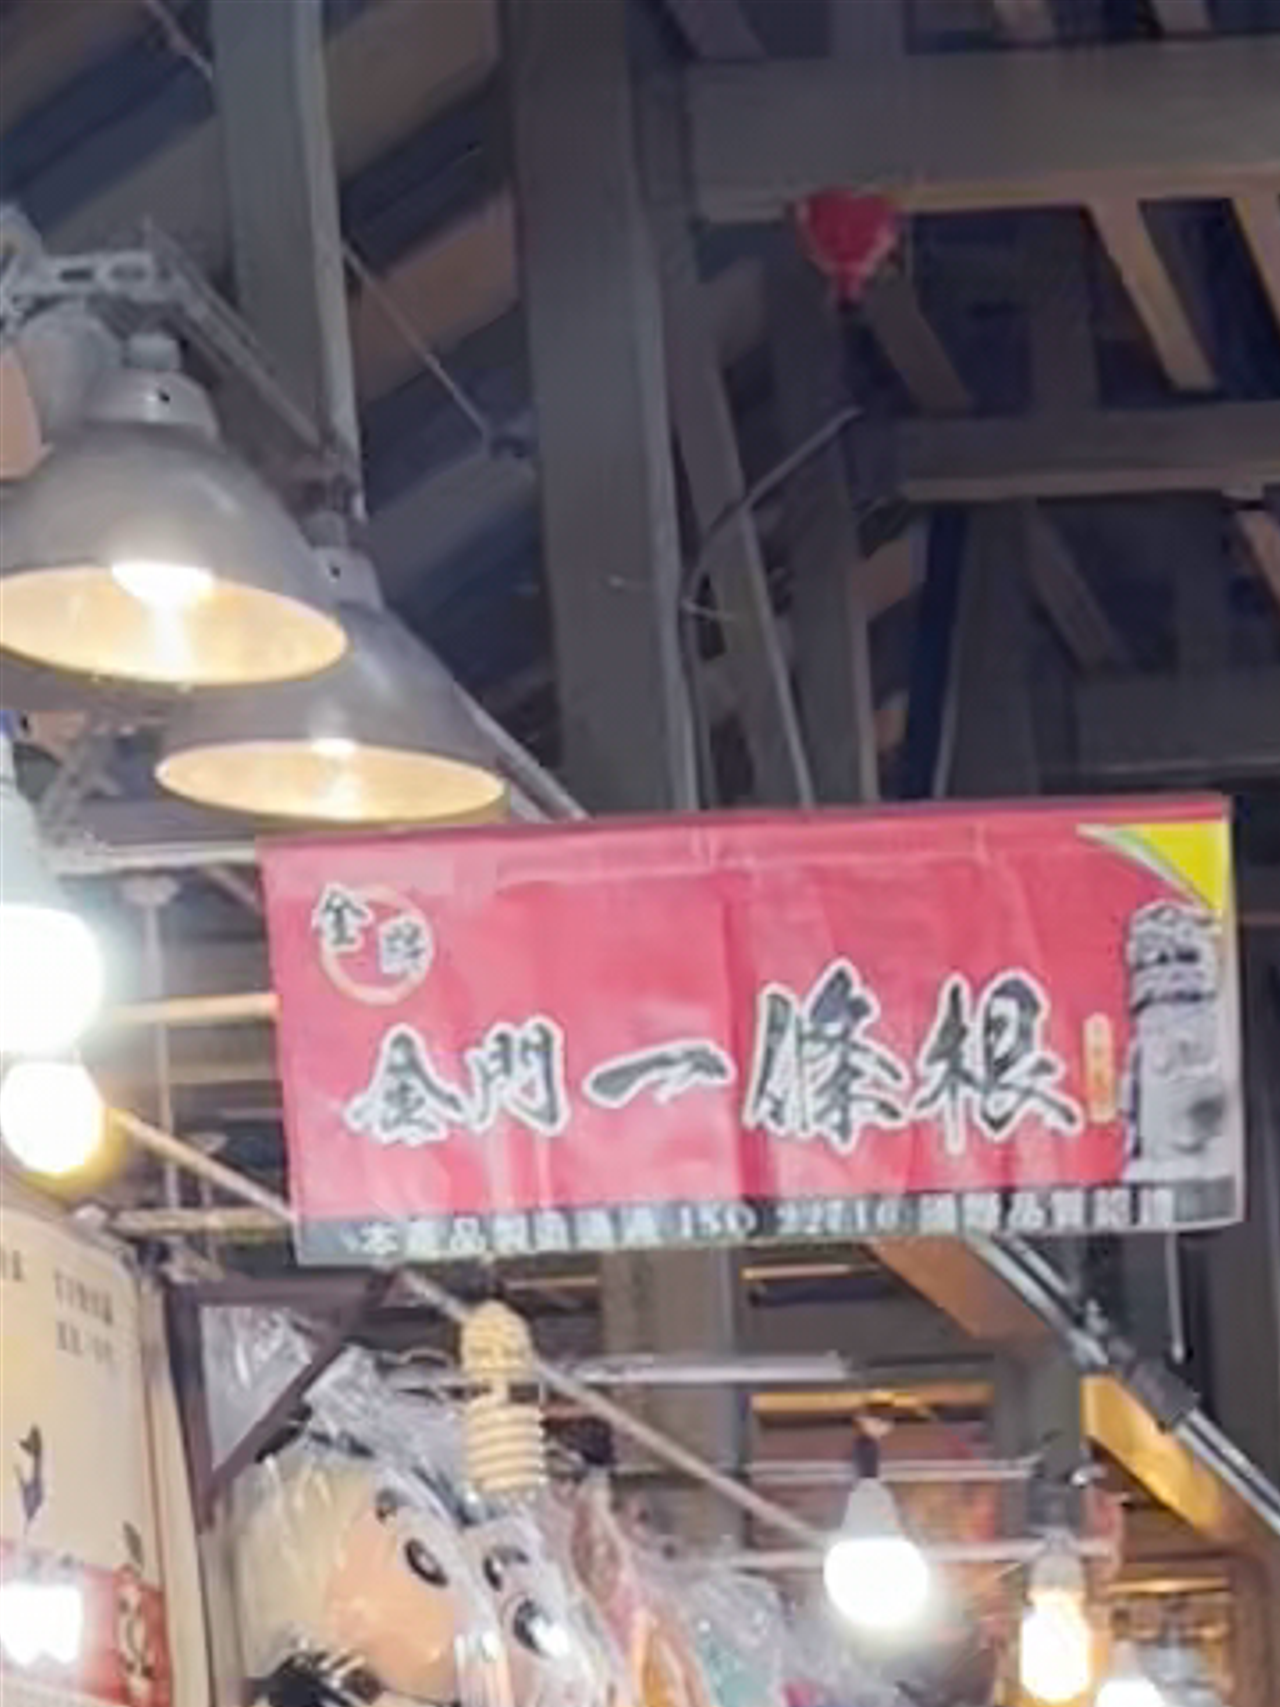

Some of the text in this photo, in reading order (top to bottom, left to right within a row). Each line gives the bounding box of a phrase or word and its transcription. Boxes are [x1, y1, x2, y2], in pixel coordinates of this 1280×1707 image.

[348, 960, 1078, 1150] 金門一條根
